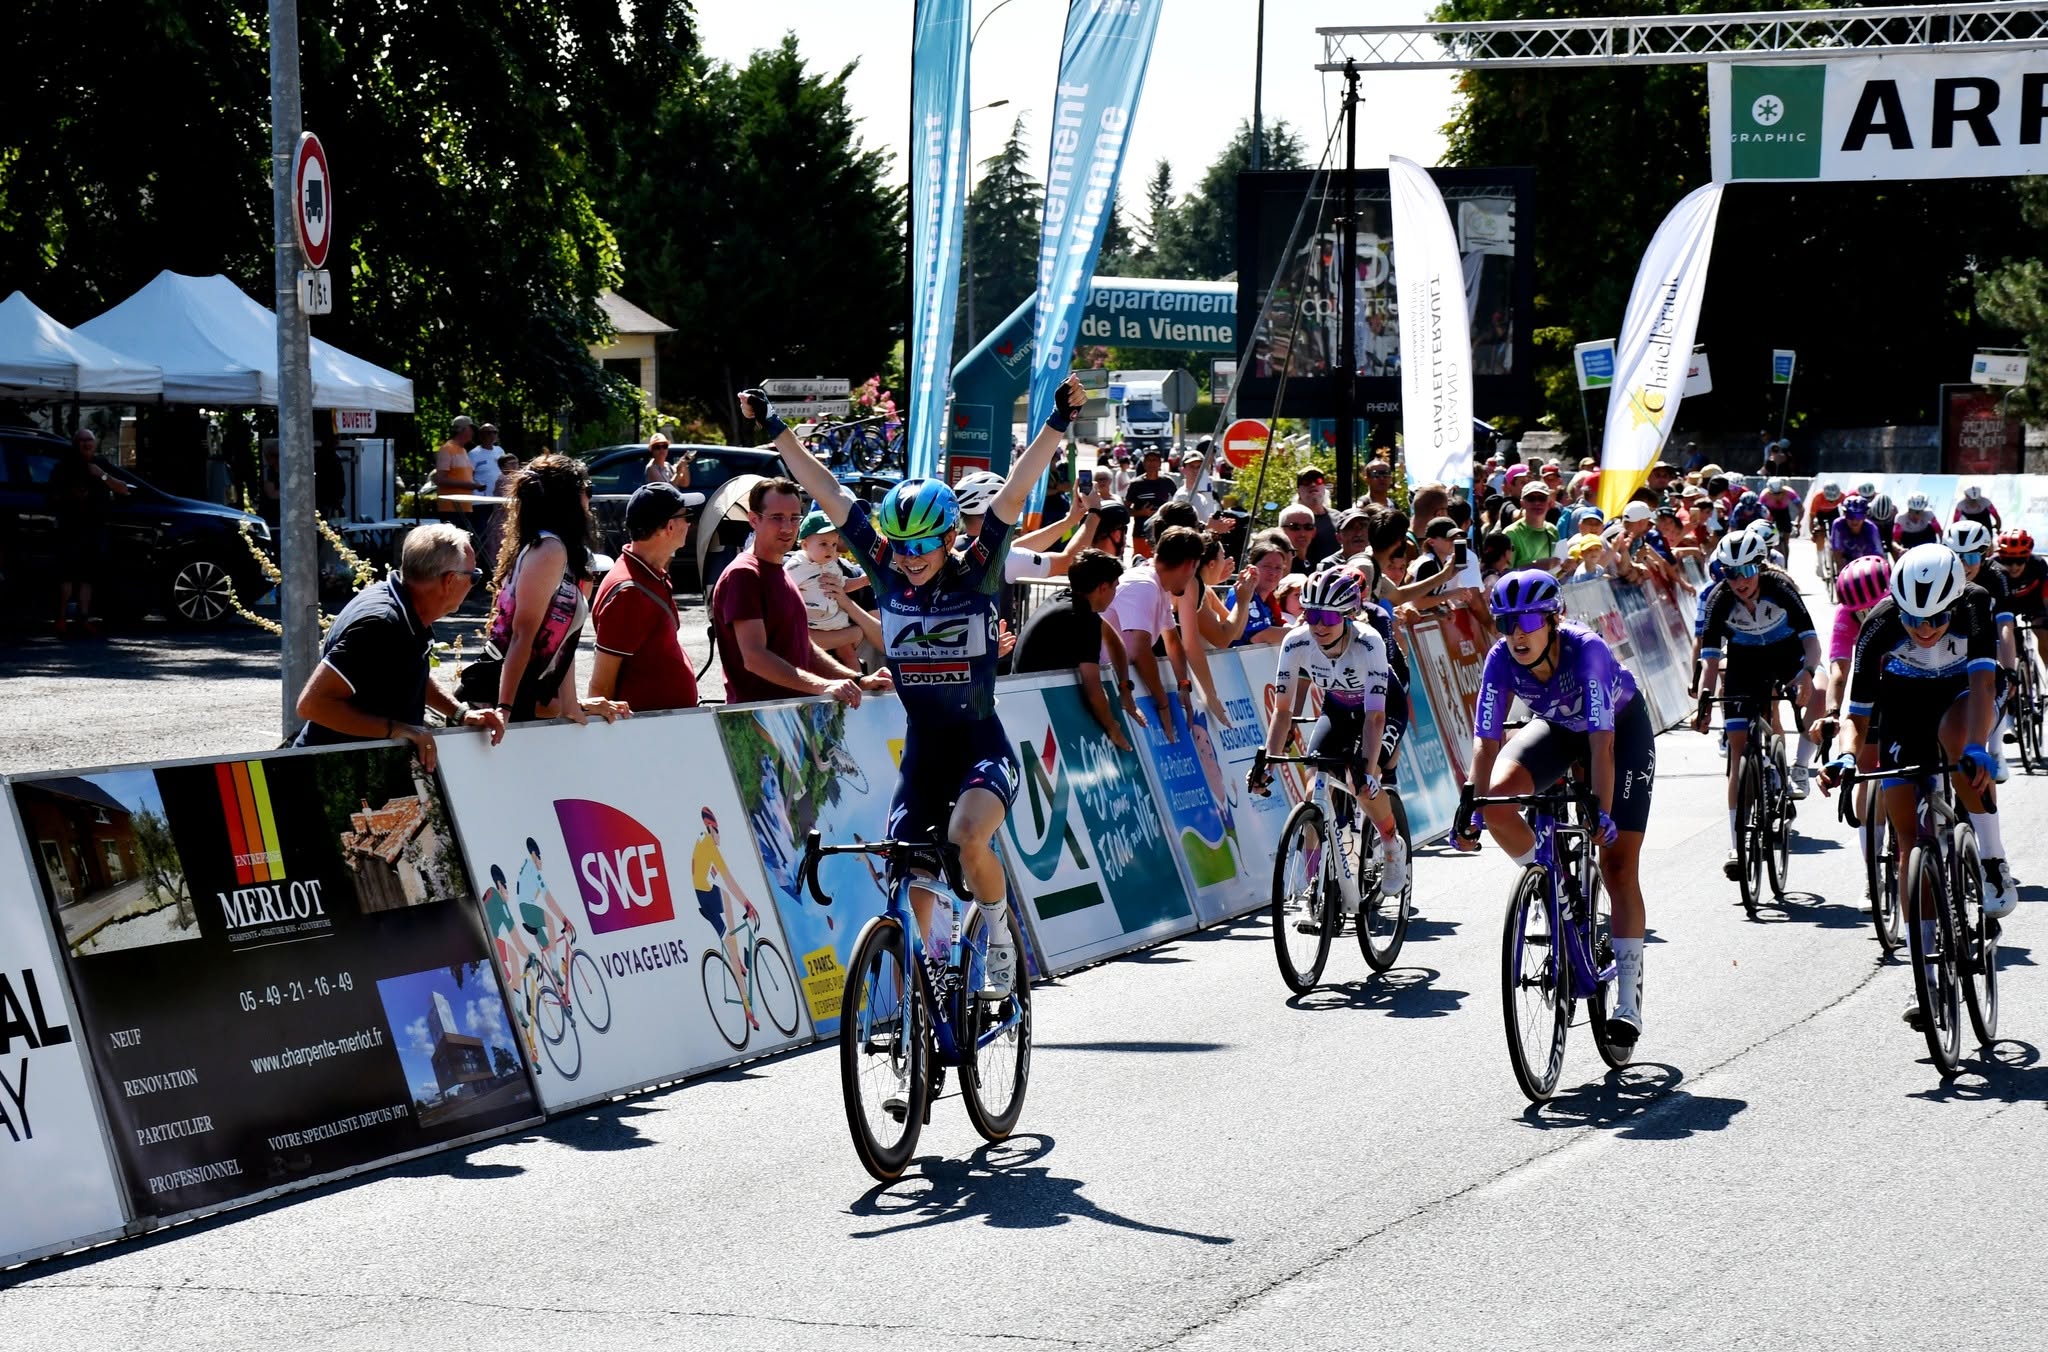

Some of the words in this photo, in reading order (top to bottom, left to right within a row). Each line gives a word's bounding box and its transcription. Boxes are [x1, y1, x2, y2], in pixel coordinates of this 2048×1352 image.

[1081, 315, 1111, 337] de
[1119, 316, 1141, 339] la
[1148, 317, 1233, 343] Vienne
[342, 412, 372, 429] BUVETTE
[1366, 402, 1399, 412] PHENIX
[891, 617, 970, 649] AG
[891, 649, 969, 657] INSURANCE
[902, 672, 970, 685] SOUDAL
[1313, 676, 1365, 690] UAE
[1225, 698, 1255, 721] TOUTES
[1482, 682, 1498, 731] Jayco
[1588, 679, 1603, 727] Jayco
[1218, 724, 1263, 751] ASSURANCES
[1623, 769, 1633, 799] CADEX
[581, 844, 659, 915] SNCF
[217, 880, 325, 929] MERLOT
[600, 939, 689, 979] VOYAGEURS
[110, 1028, 142, 1049] NEUF
[251, 1027, 384, 1074] www.charpente-merlot.fr
[123, 1068, 199, 1097] RENOVATION
[136, 1115, 215, 1146] PARTICULIER
[268, 1132, 303, 1151] VOTRE
[302, 1116, 360, 1144] SPECIALISTE
[360, 1108, 393, 1128] DEPUIS
[392, 1104, 409, 1120] 1971
[149, 1158, 243, 1194] PROFESSIONNEL
